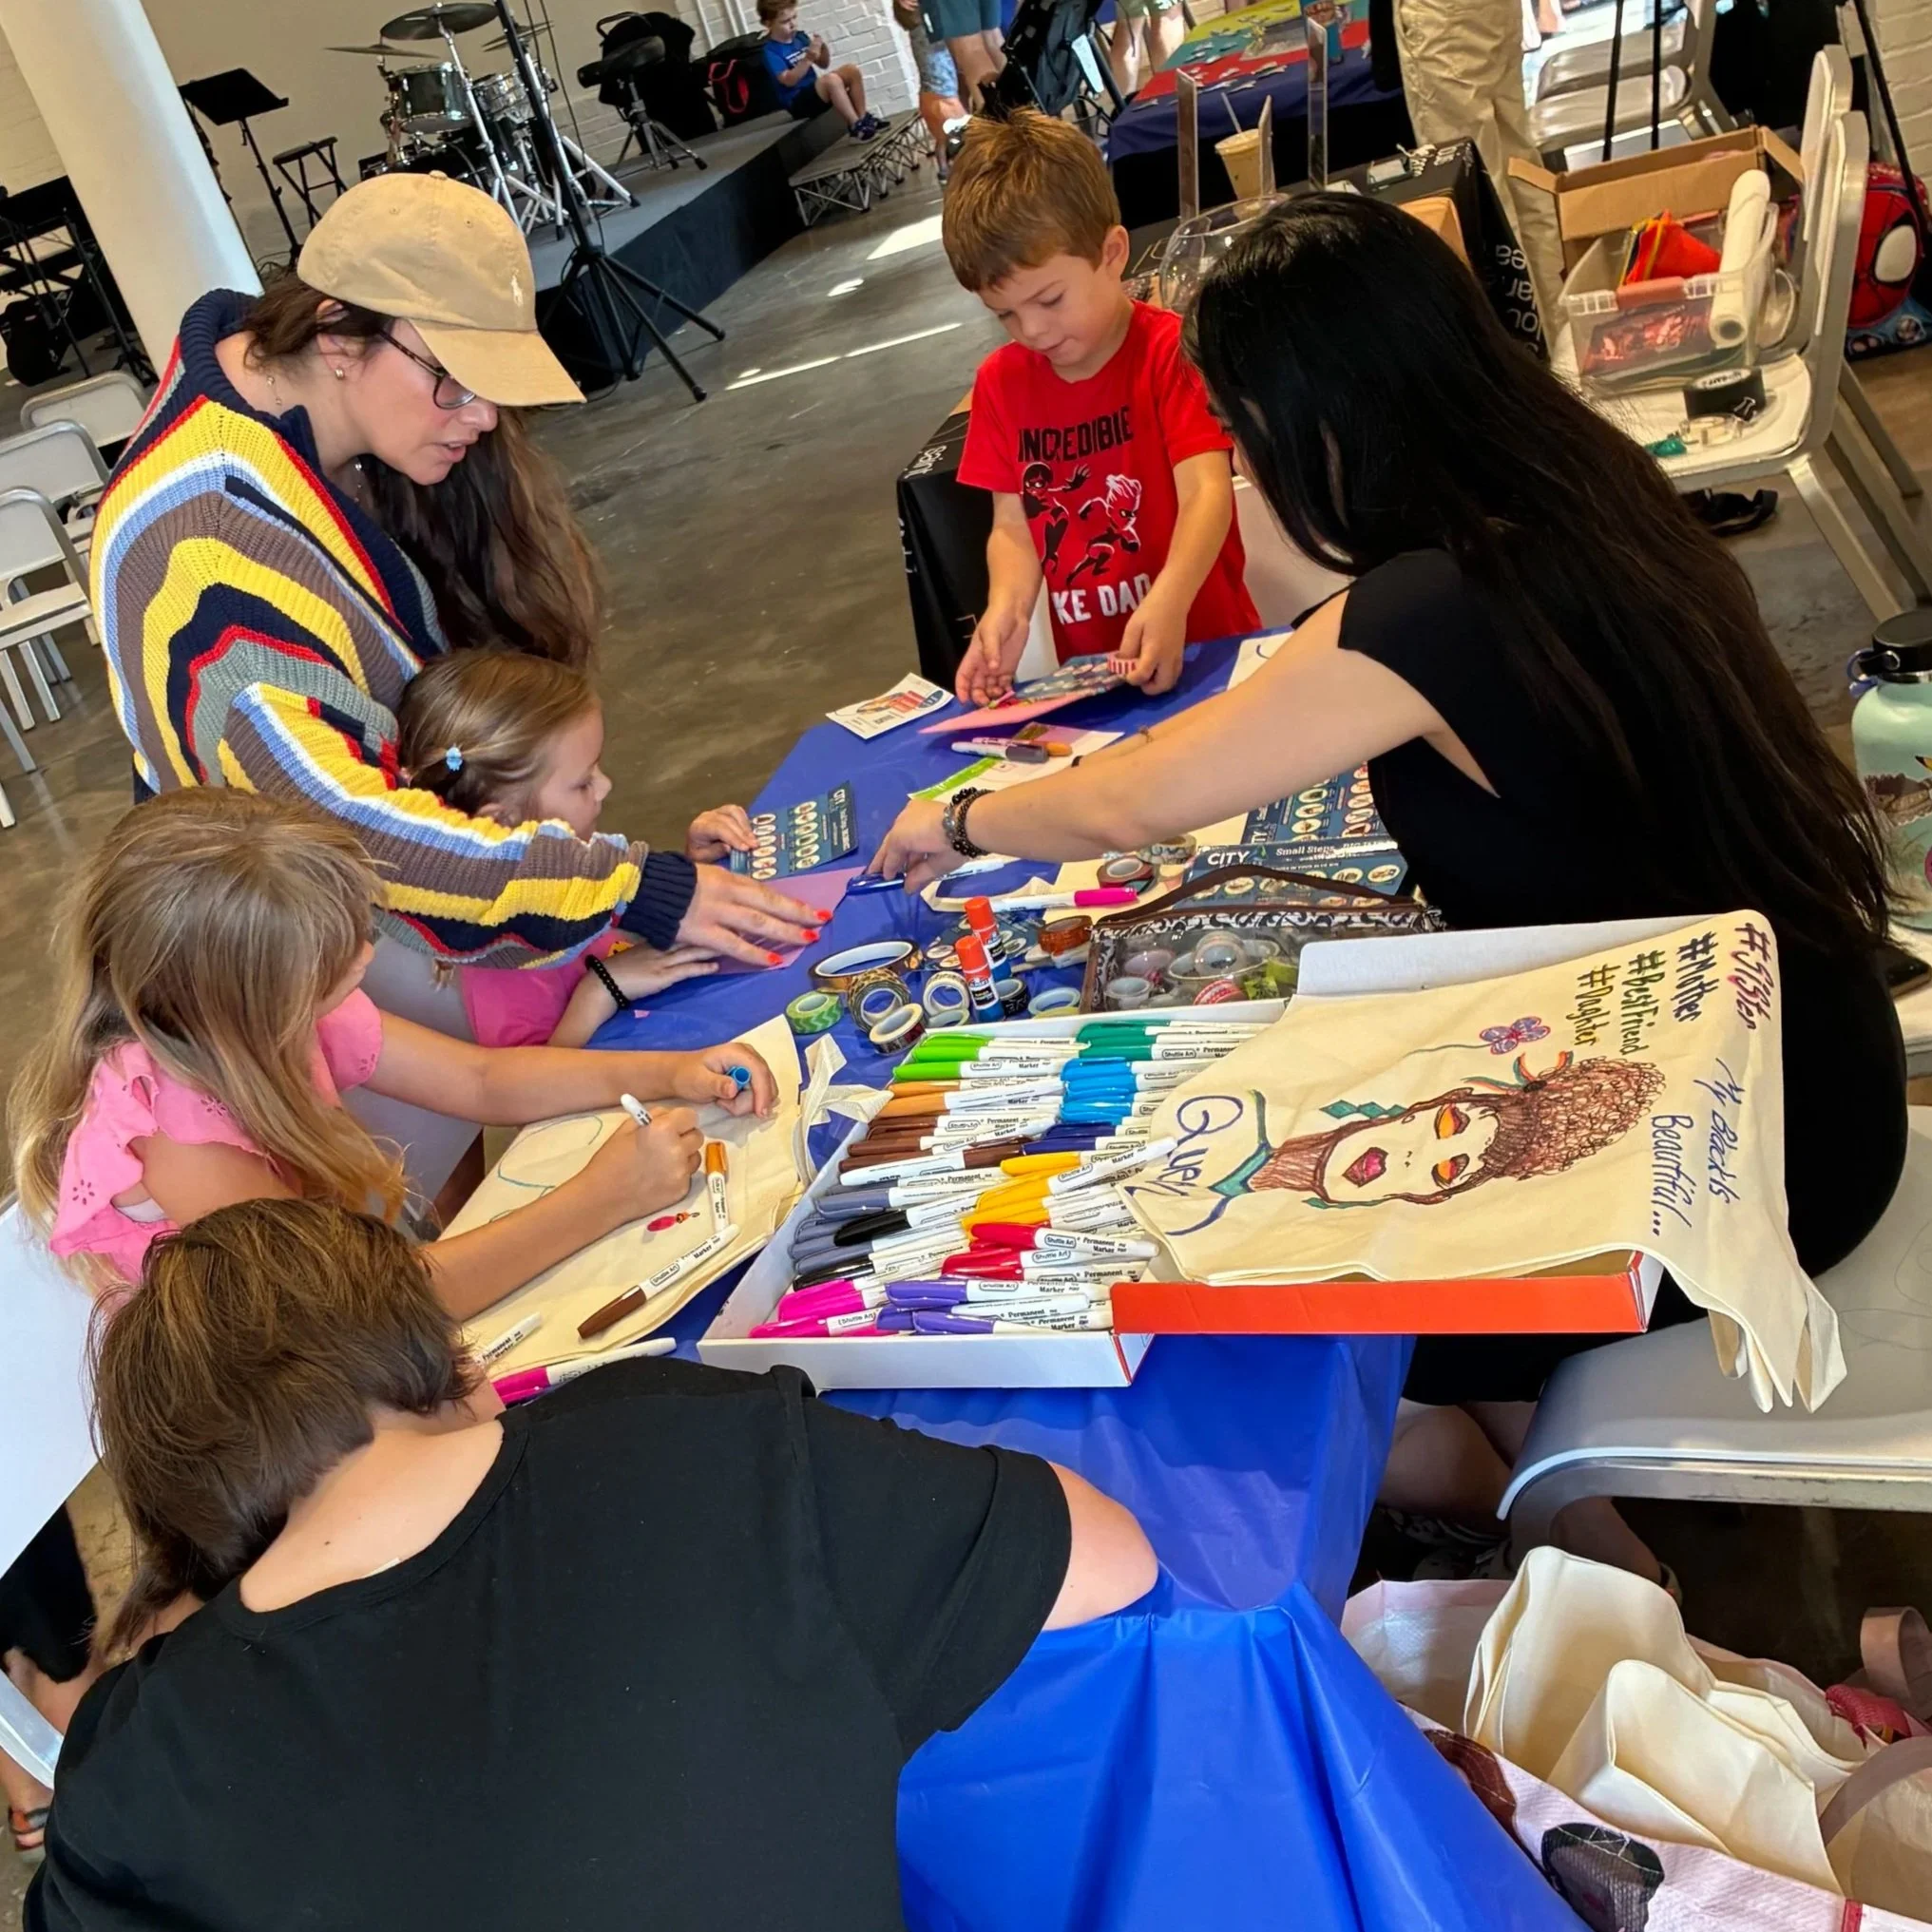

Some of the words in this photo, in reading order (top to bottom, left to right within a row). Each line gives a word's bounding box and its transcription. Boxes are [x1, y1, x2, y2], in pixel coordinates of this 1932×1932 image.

[1051, 589, 1091, 624] KE
[1276, 846, 1306, 856] Small
[1207, 850, 1250, 866] CITY
[1693, 1057, 1745, 1107] My
[994, 1128, 1016, 1137] Marker
[1708, 1109, 1738, 1181] Black
[1112, 1152, 1134, 1164] Marker
[1082, 1237, 1116, 1246] Permanent
[693, 1245, 713, 1259] Marker
[1093, 1245, 1116, 1253] Marker
[1084, 1270, 1122, 1278] Permanent
[1008, 1309, 1044, 1317] Permanent
[1039, 1315, 1075, 1325] Permanent
